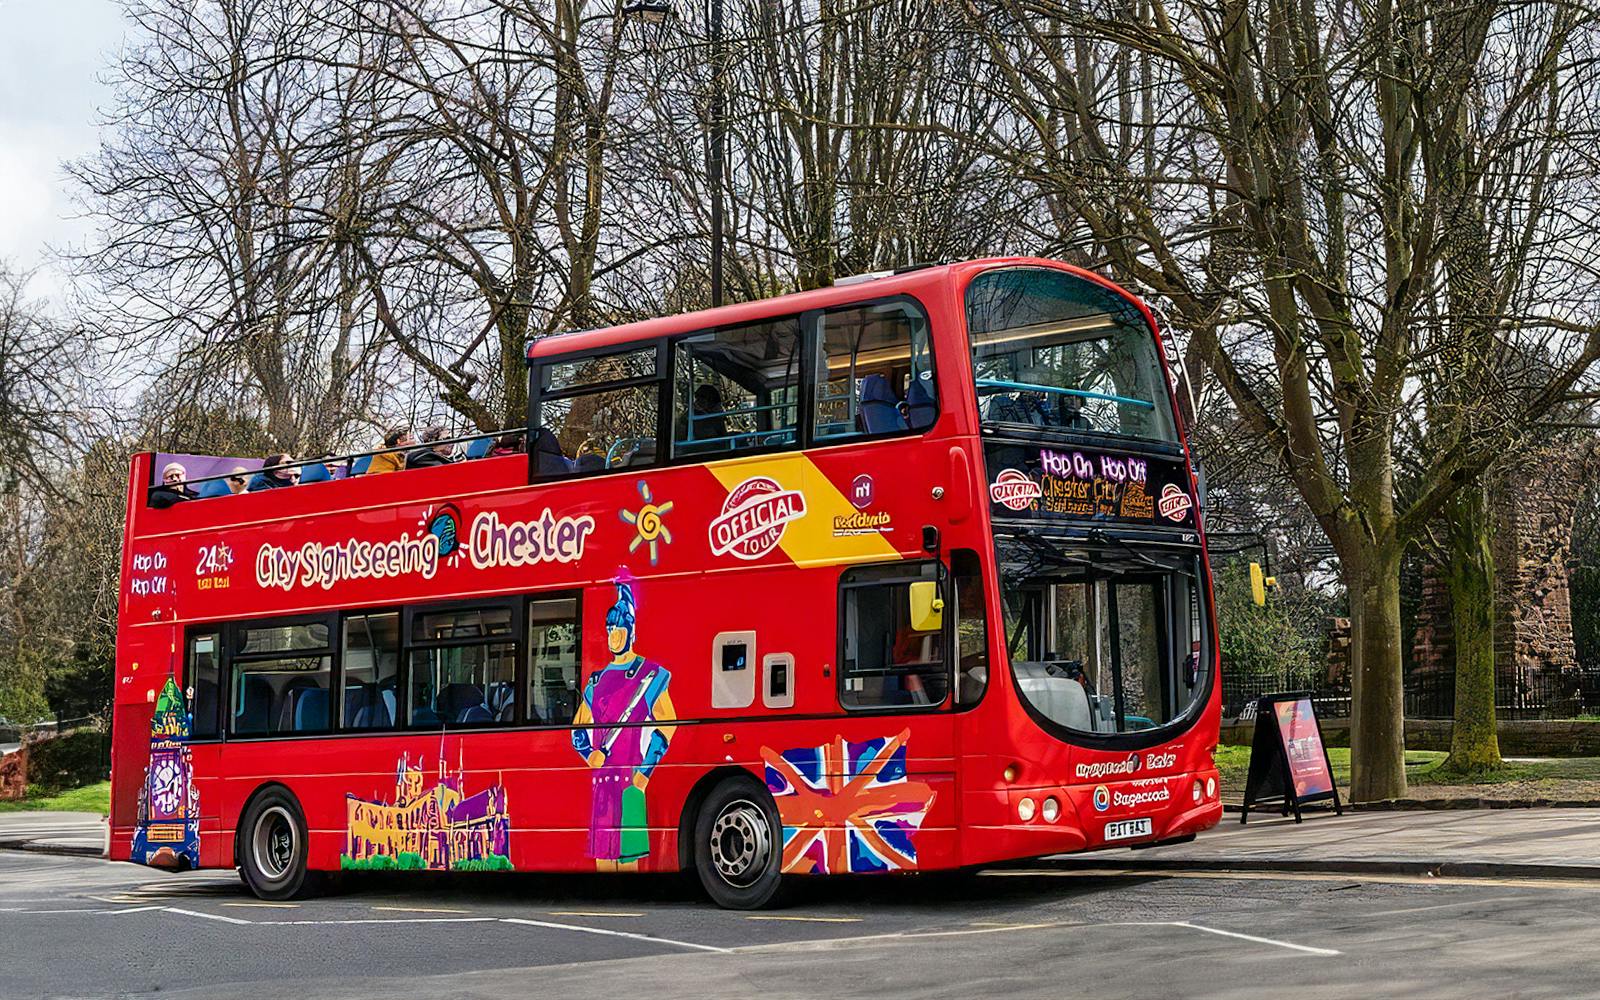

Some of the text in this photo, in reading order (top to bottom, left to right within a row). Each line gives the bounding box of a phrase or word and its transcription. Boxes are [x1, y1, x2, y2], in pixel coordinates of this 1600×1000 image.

[1073, 452, 1094, 479] On
[716, 495, 799, 545] OFFICIAL
[470, 507, 595, 569] Chester
[743, 527, 780, 554] TOUR
[133, 552, 167, 573] Hop On
[131, 578, 150, 598] Hop
